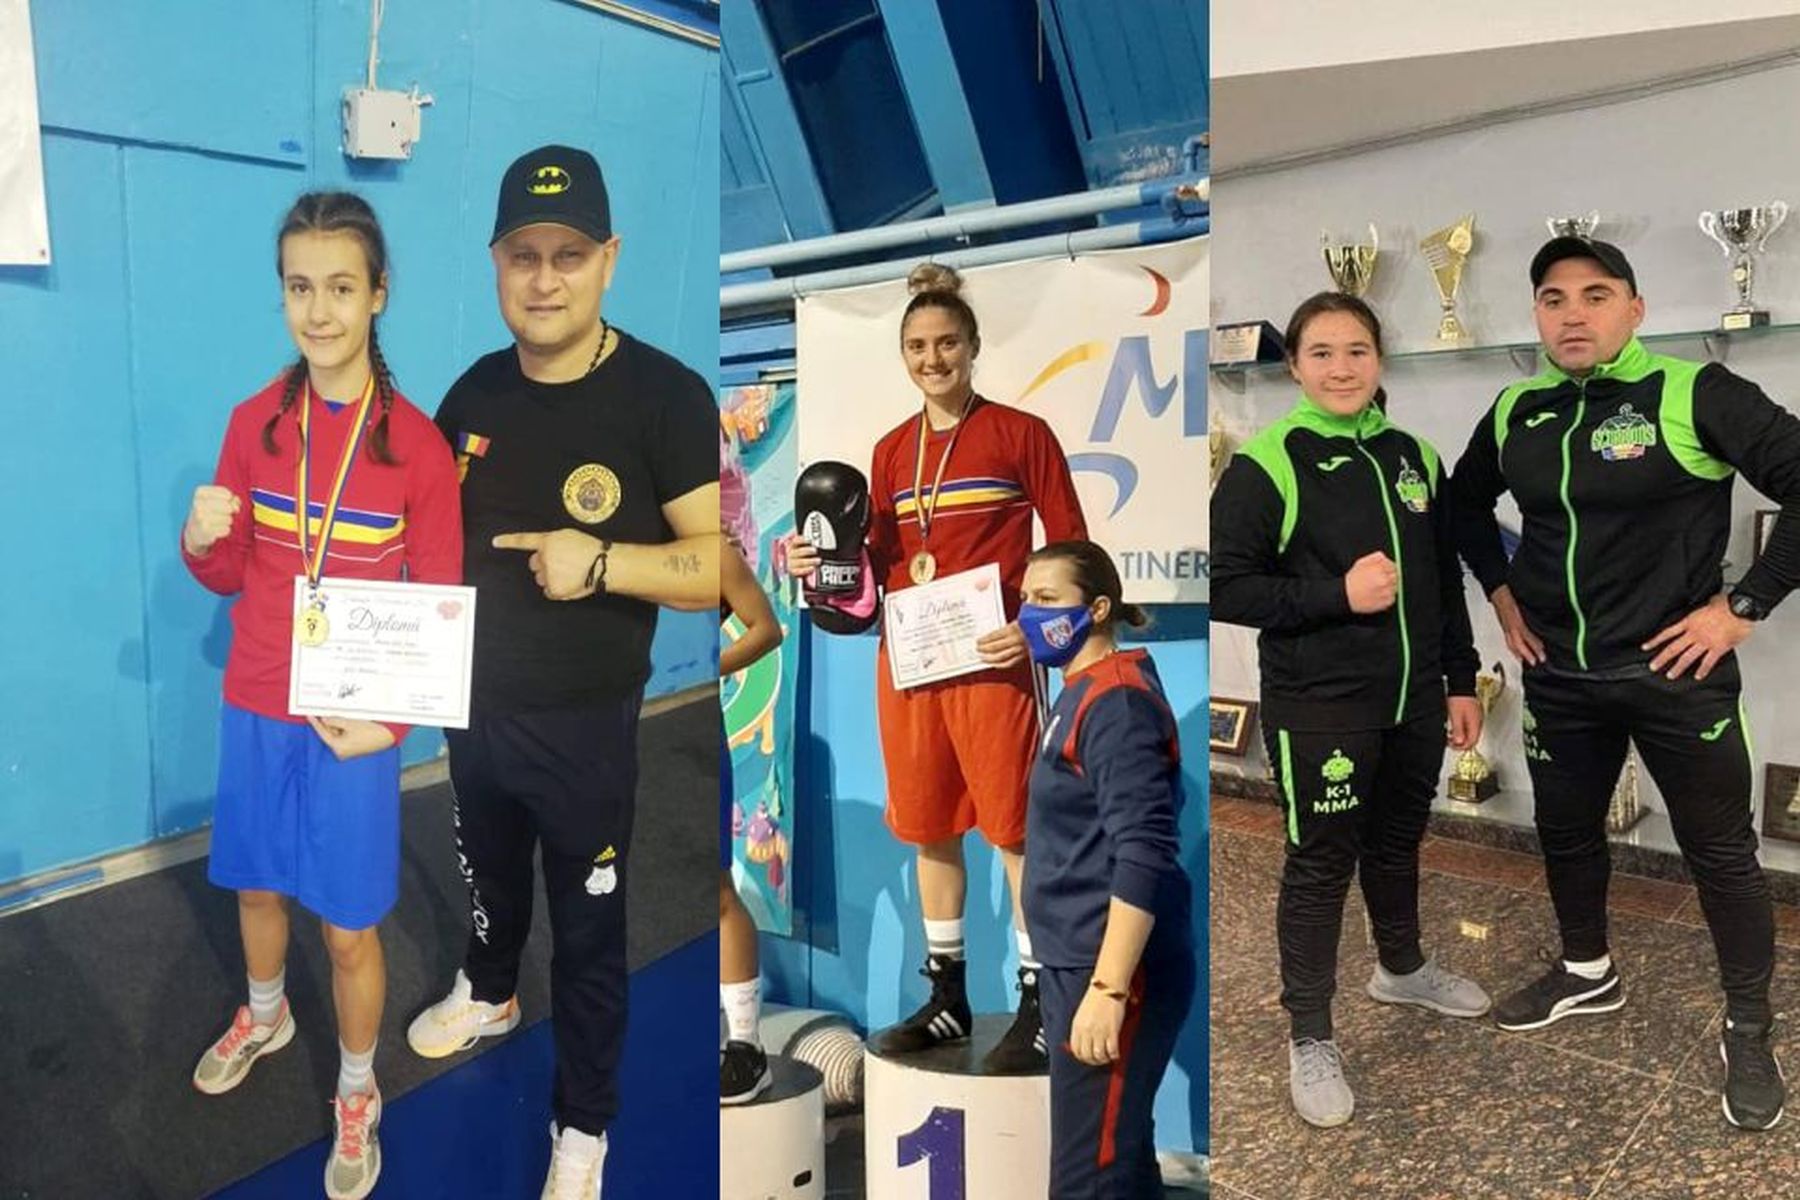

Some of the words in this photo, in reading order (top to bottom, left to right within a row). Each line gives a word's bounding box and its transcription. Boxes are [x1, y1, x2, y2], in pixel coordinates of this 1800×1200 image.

[1120, 550, 1209, 579] TINER
[1326, 783, 1351, 799] K-1
[1313, 795, 1359, 813] MMA
[897, 1106, 966, 1200] 1
